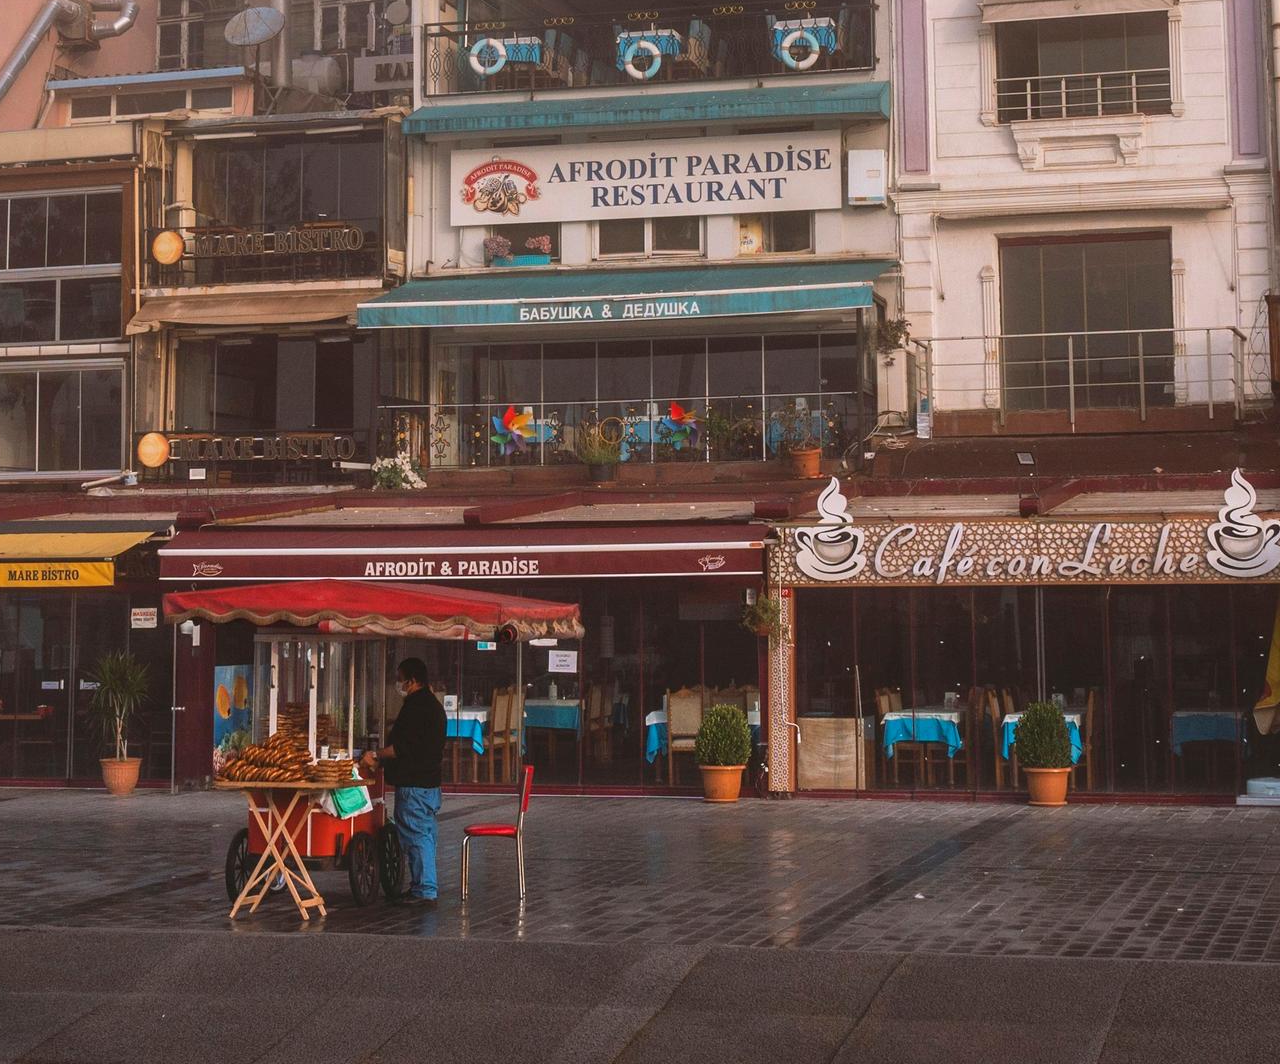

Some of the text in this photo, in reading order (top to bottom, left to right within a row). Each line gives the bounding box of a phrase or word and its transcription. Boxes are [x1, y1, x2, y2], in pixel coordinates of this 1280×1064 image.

[547, 144, 832, 184] AFRODİT PARADİSE
[590, 177, 787, 208] RESTAURANT
[194, 225, 364, 257] MARE BİSTRO
[520, 301, 701, 321] БАБУШКА & ДЕДУШКА
[179, 436, 255, 461] MARE
[364, 556, 539, 576] AFRODİT & PARADİSE
[874, 522, 1200, 585] Café con Leche
[8, 567, 79, 581] MARE BİSTRO
